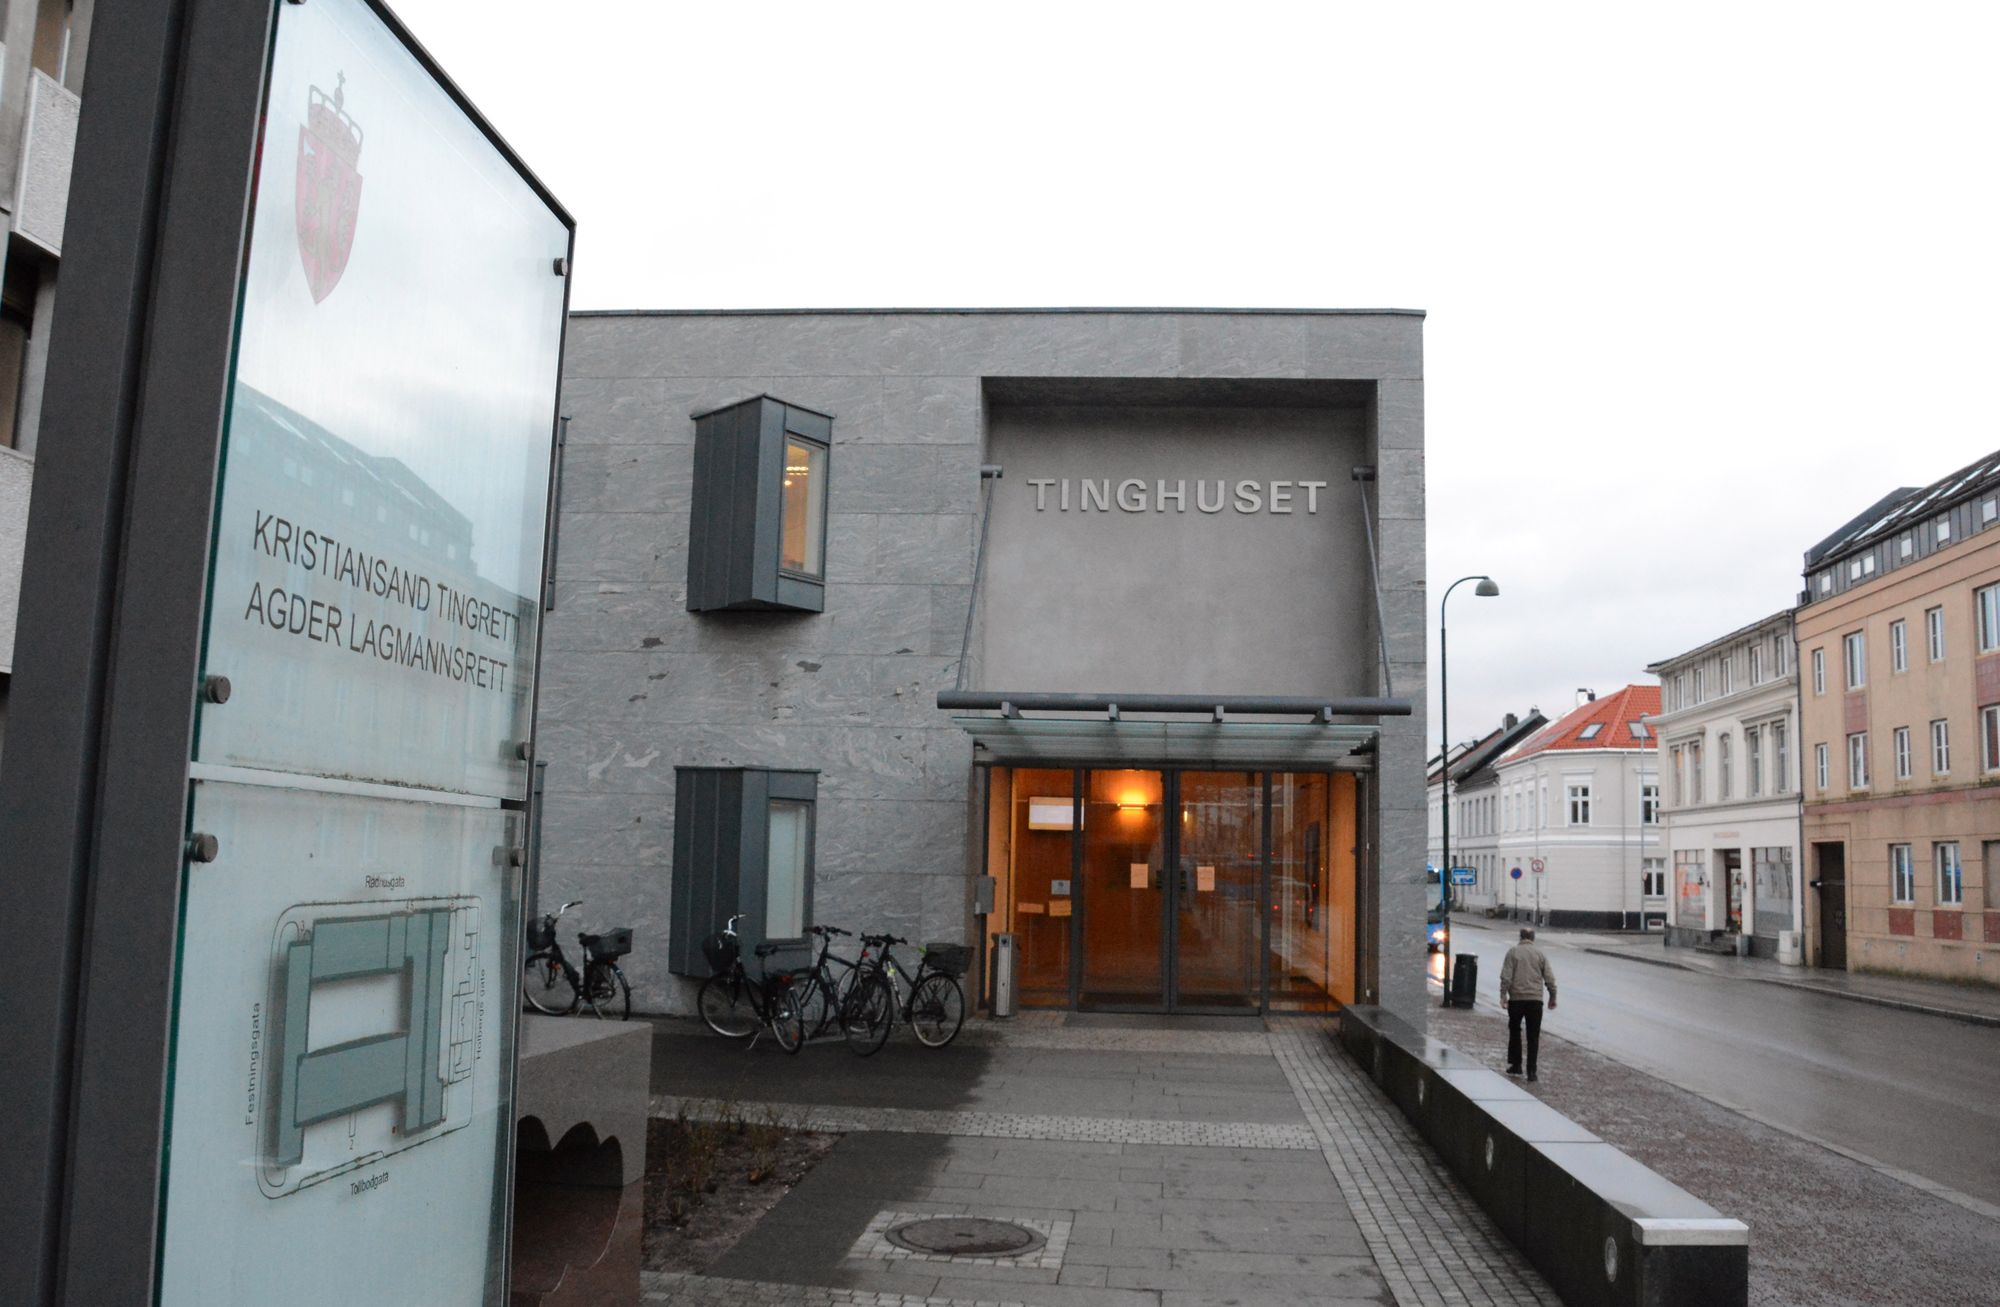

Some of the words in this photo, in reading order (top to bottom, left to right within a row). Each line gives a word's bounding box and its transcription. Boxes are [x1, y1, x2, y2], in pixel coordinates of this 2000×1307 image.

[1026, 478, 1327, 514] TINGHUSET
[253, 509, 430, 612] KRISTIANSAND
[437, 582, 521, 645] TINGRETT
[244, 581, 343, 647] AGDER
[349, 612, 508, 693] LAGMANNSRETT
[245, 1002, 261, 1126] Festningsgata
[350, 1171, 389, 1196] Tollbodgata
